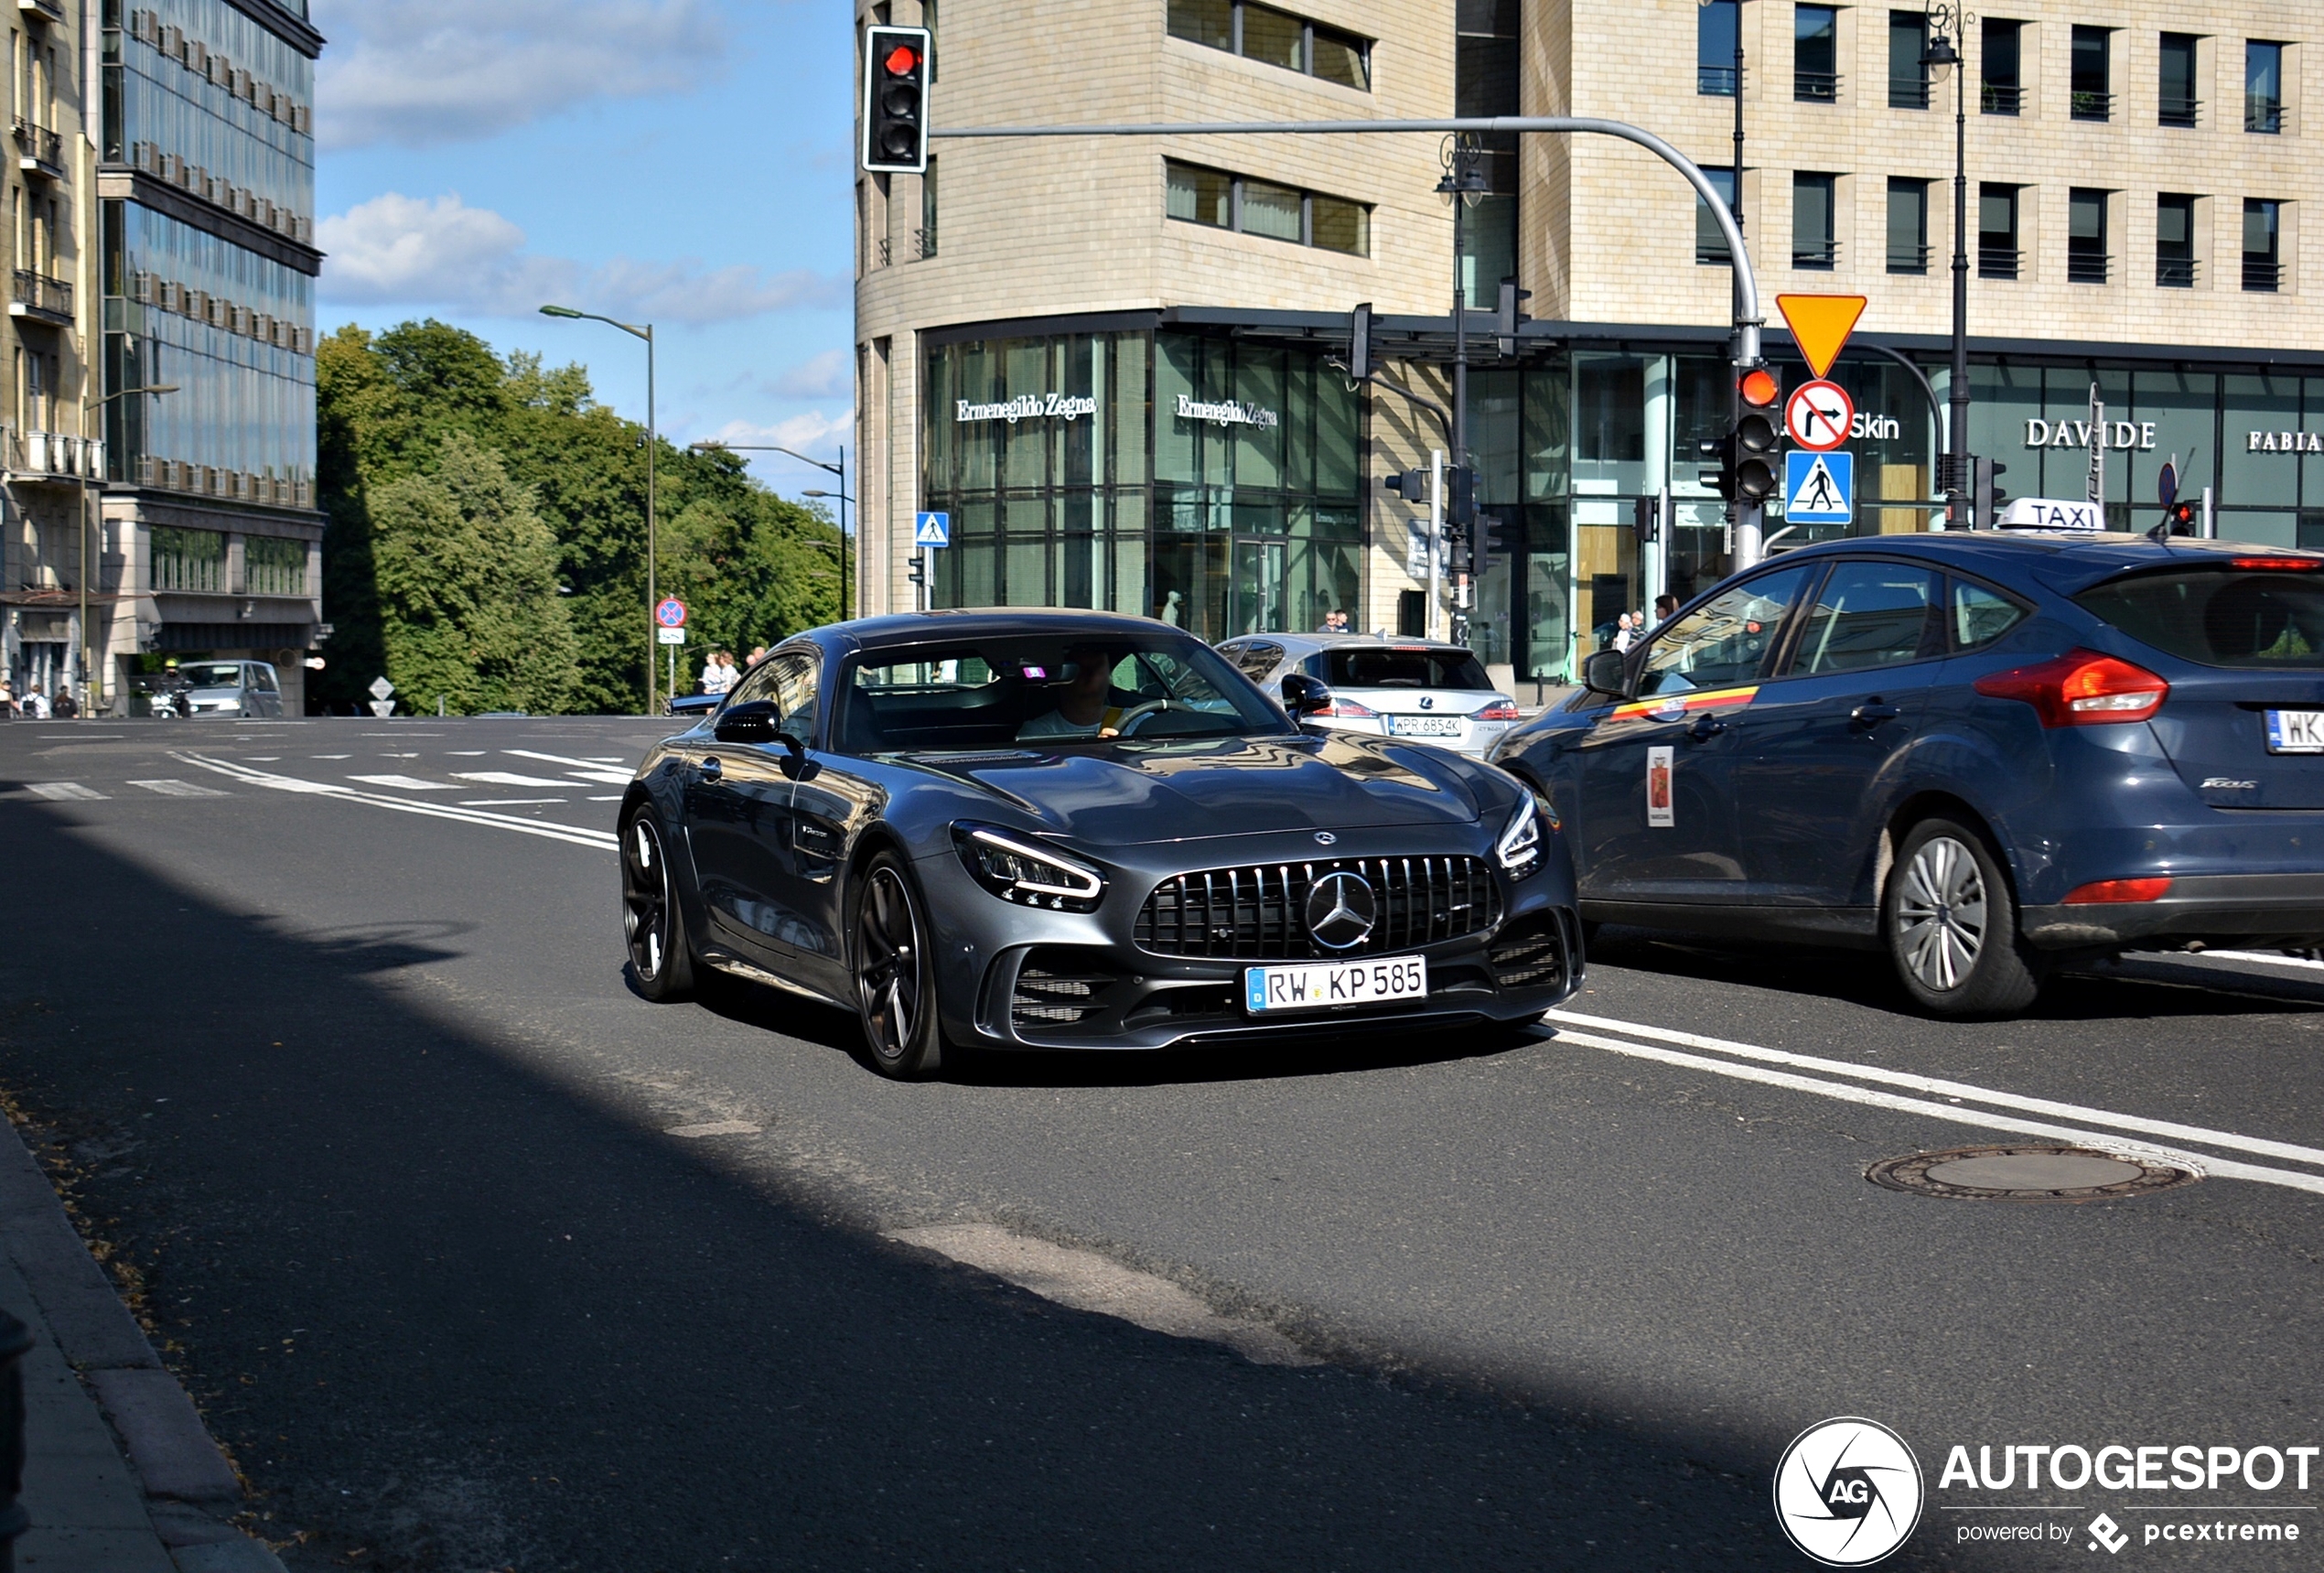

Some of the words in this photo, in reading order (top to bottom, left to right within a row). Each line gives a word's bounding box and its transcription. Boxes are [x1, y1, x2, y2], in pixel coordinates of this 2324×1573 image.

[956, 394, 1044, 424] Ermenegildo
[1045, 393, 1097, 421] Zegna
[1177, 394, 1245, 427] Ermenegildo
[1244, 402, 1278, 431] Zegna
[1849, 412, 1899, 439] Skin
[2027, 419, 2156, 448] DAVIDE
[2248, 431, 2321, 451] FABIA
[2031, 504, 2095, 527] TAXI
[2286, 714, 2323, 743] WK
[1268, 972, 1307, 1003] RW
